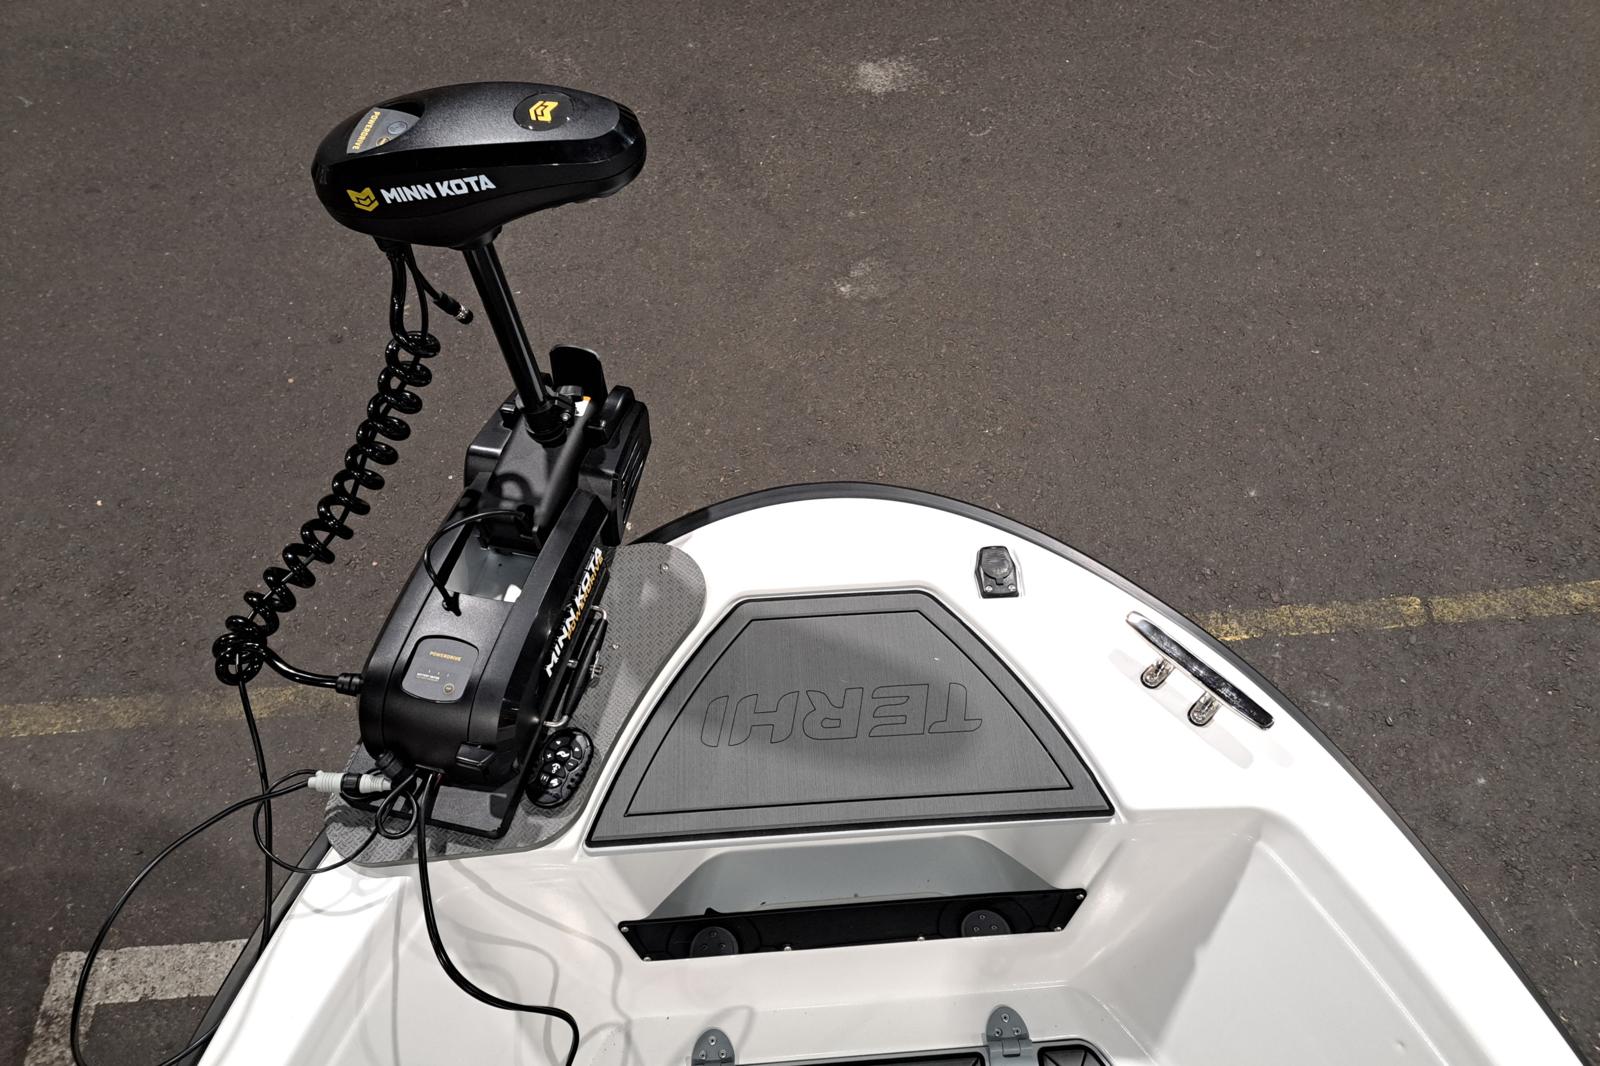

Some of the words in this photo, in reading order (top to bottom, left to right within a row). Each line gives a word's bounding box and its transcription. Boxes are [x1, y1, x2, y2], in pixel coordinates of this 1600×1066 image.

[352, 111, 381, 151] POWERDRIVE
[380, 183, 437, 204] MINN
[437, 174, 496, 197] KOTA
[545, 607, 576, 678] MINN
[575, 547, 602, 608] KOTA
[700, 682, 983, 747] TERHI
